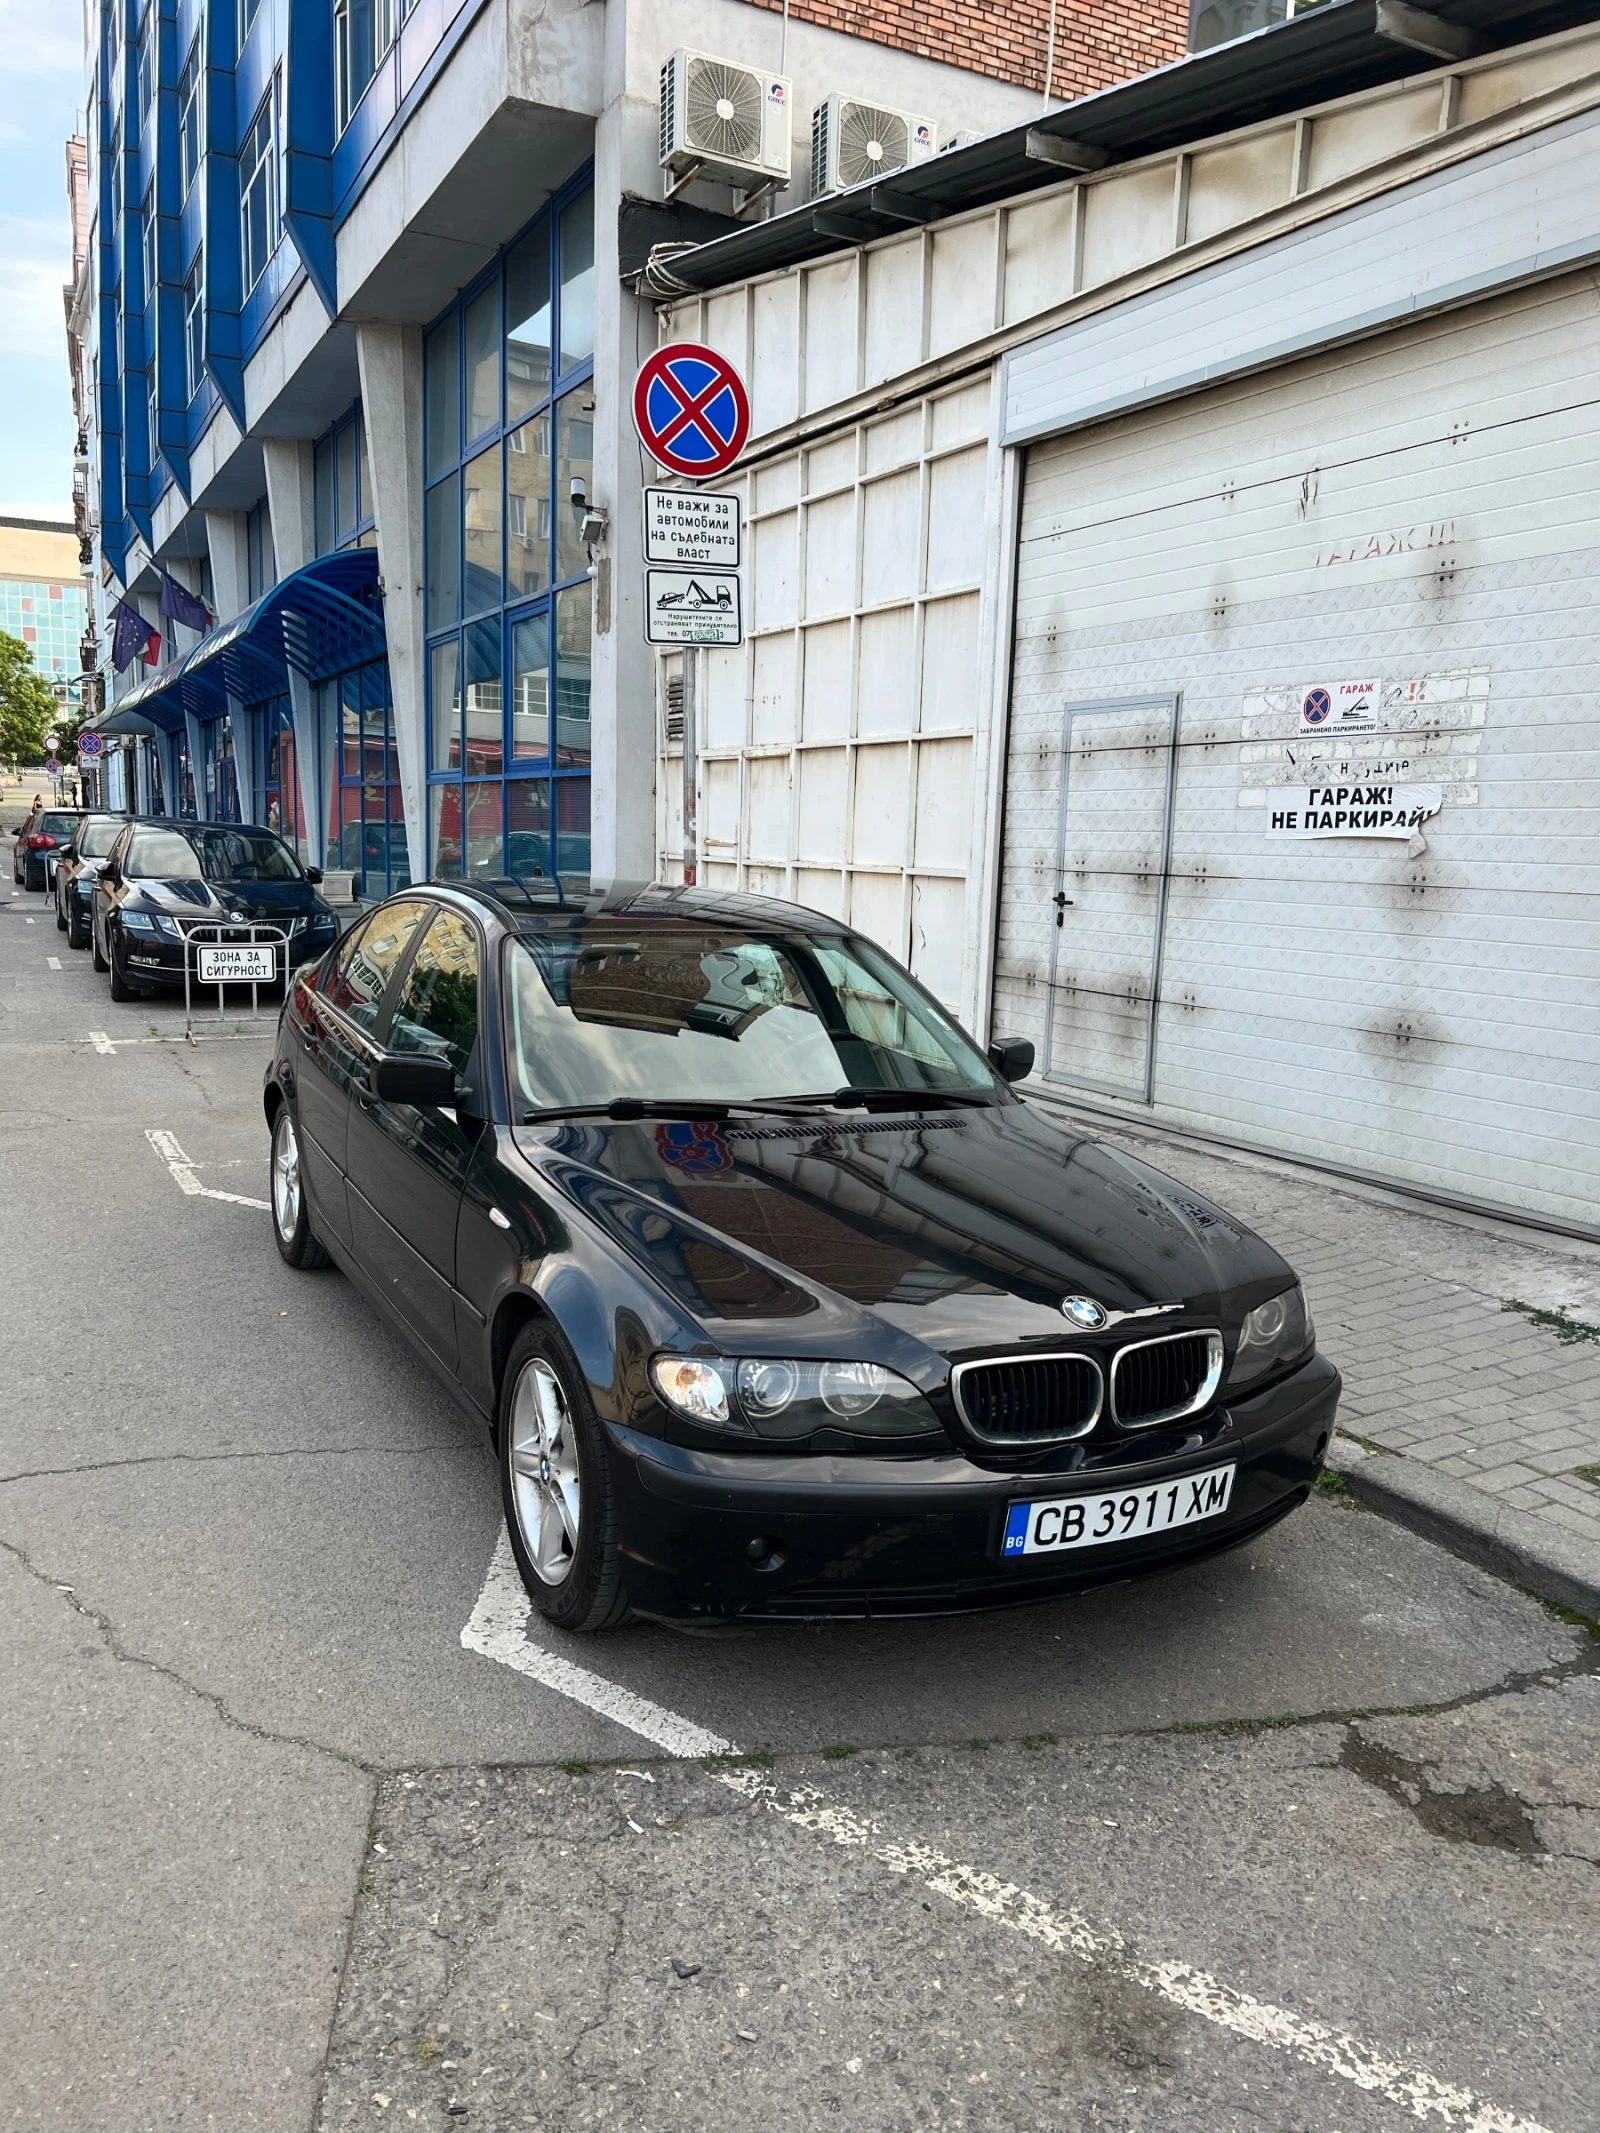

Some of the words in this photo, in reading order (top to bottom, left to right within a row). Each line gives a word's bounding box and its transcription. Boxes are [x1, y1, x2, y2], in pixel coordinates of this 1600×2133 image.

[657, 495, 672, 509] Не
[677, 500, 710, 512] важи
[715, 504, 728, 514] за
[657, 514, 729, 530] автомобили
[651, 530, 665, 541] на
[671, 531, 735, 545] съдебната
[677, 548, 710, 559] власт
[668, 613, 712, 621] Нарушителите
[1340, 683, 1374, 695] ГАРАЖ
[1300, 726, 1332, 734] ЗАБРАНЕНО
[1332, 724, 1376, 733] ПАРКИРАНЕТО!
[1309, 787, 1393, 805] ГАРАЖ!
[1271, 812, 1298, 829] НЕ
[213, 952, 241, 962] ЗОНА
[247, 952, 260, 962] ЗА
[206, 965, 268, 976] СИГУРНОСТ
[1034, 1503, 1085, 1546] CB
[1092, 1485, 1179, 1538] 3911
[1185, 1471, 1229, 1519] XM
[1006, 1536, 1023, 1549] BG
